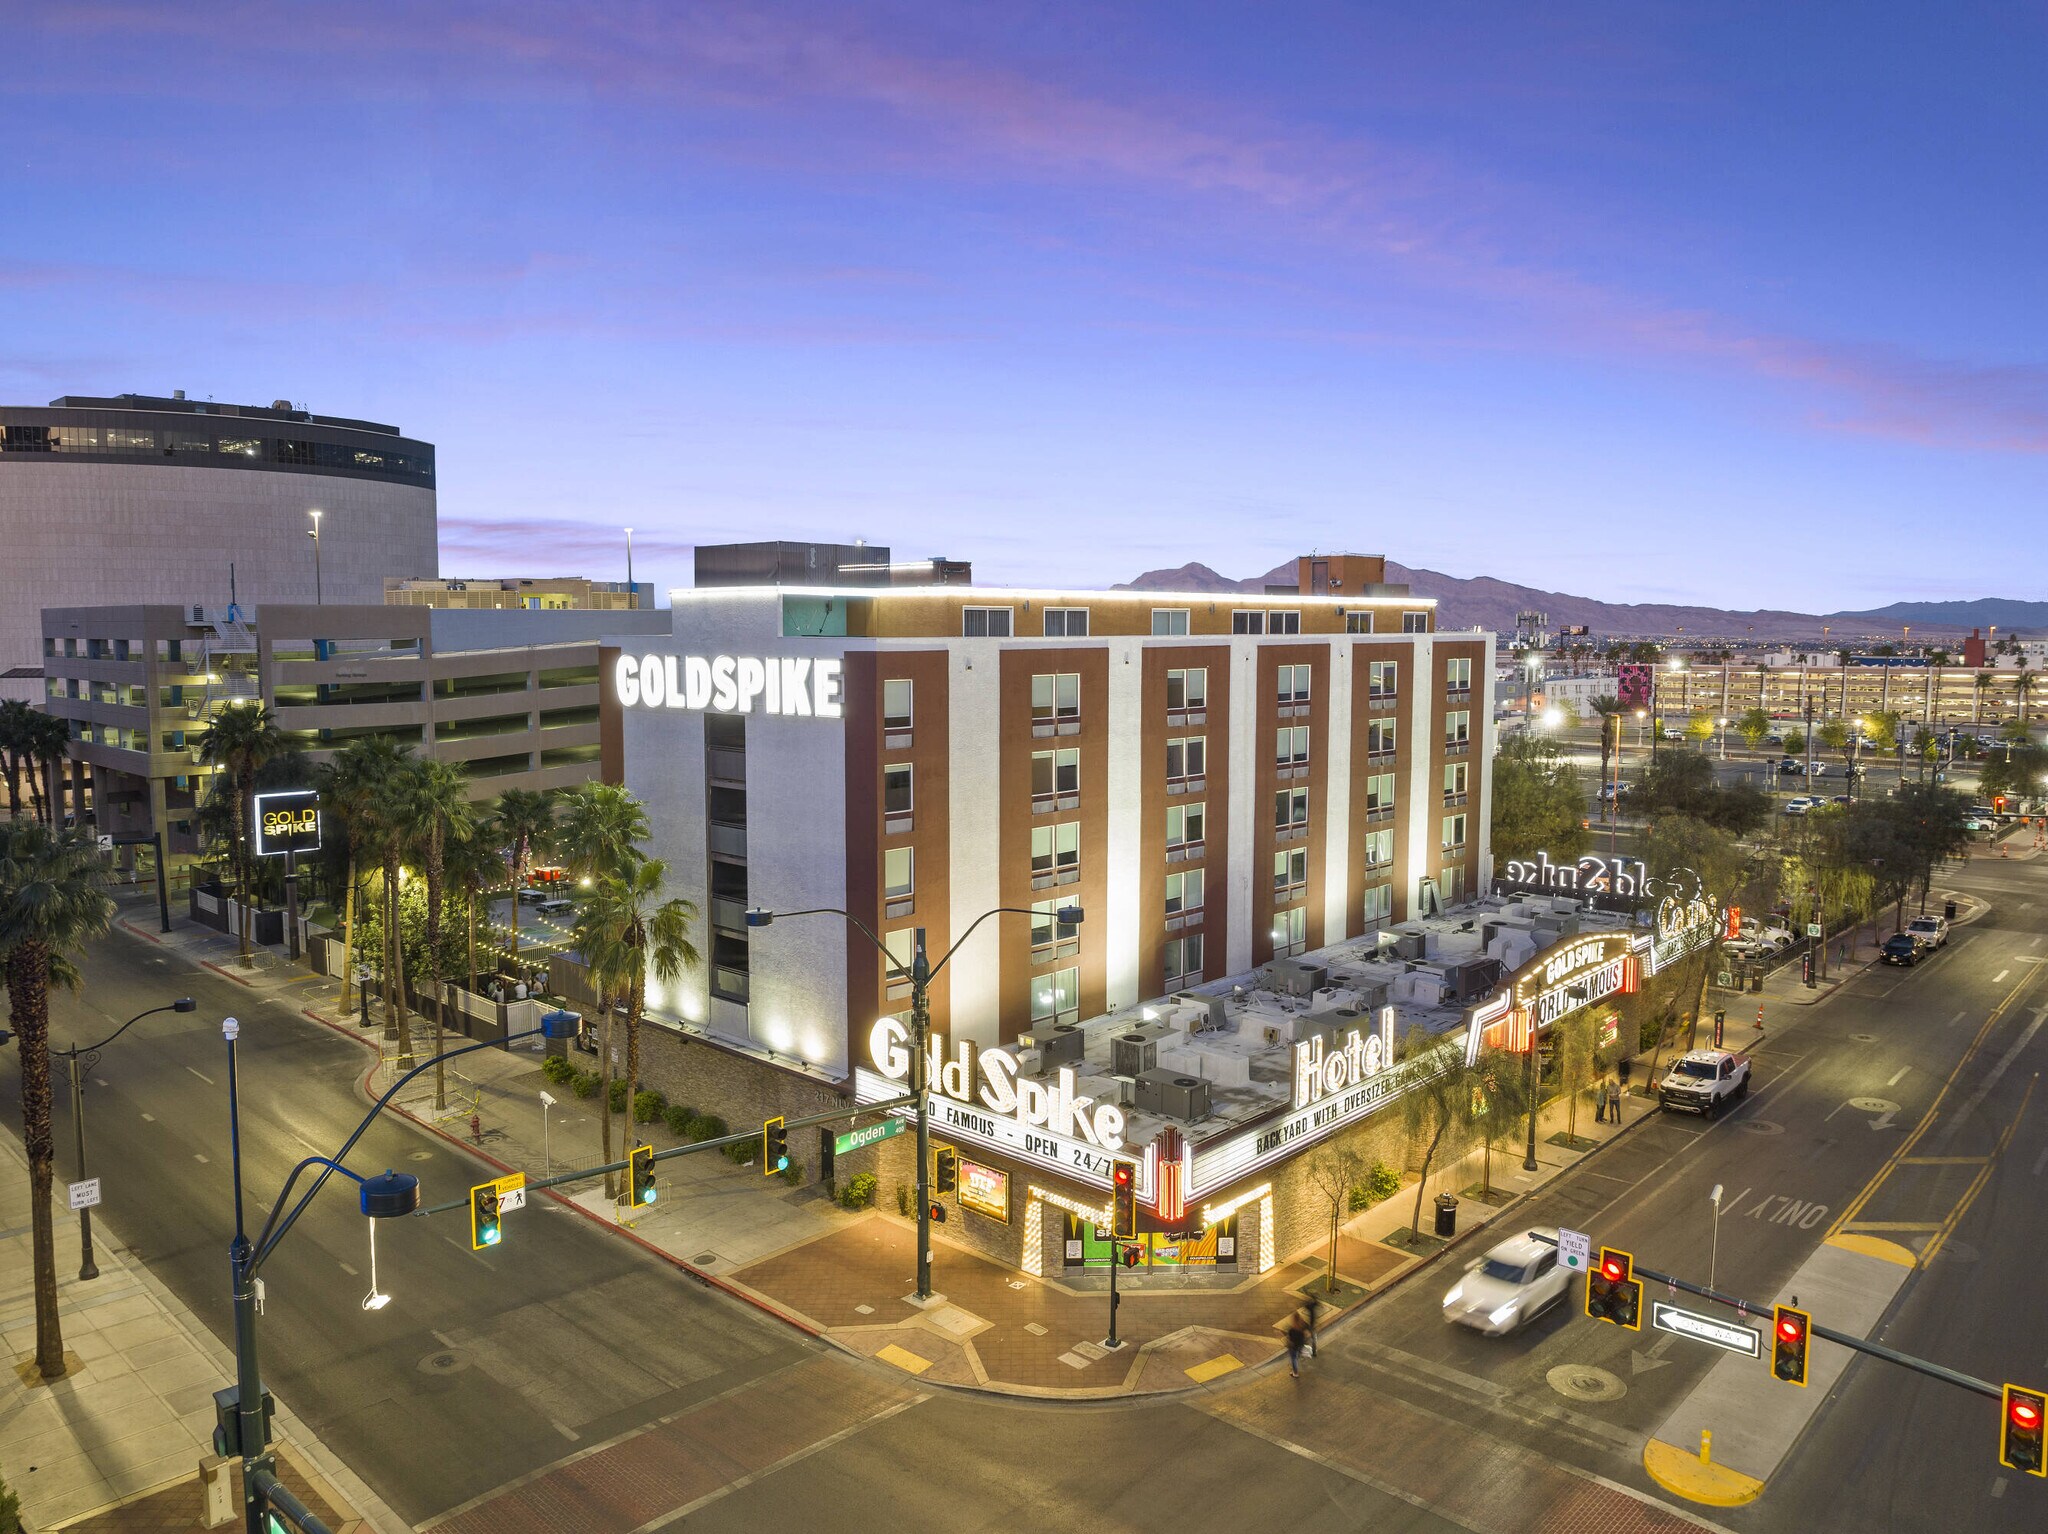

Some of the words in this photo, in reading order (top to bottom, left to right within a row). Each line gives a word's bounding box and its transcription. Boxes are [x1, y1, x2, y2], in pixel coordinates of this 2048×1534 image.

[616, 654, 844, 718] GOLDSPIKE
[263, 809, 315, 826] GOLD
[263, 821, 316, 837] SPIKE
[1295, 1006, 1395, 1111] Hotel
[869, 1017, 976, 1103] Gld
[978, 1048, 1125, 1150] Spike
[1313, 1102, 1338, 1127] WITH
[850, 1126, 886, 1147] Ogden
[895, 1118, 905, 1126] Ave
[895, 1126, 905, 1134] 400
[946, 1107, 995, 1138] FAMOUS
[1025, 1134, 1059, 1158] OPEN
[1073, 1149, 1111, 1177] 24/7
[85, 1181, 98, 1189] LANE
[501, 1181, 522, 1190] VEHICLES
[76, 1190, 93, 1198] MUST
[87, 1196, 99, 1204] LEFT
[1743, 1194, 1829, 1230] ONLY
[1560, 1231, 1571, 1239] LEFT
[1576, 1235, 1588, 1243] TURN
[1566, 1239, 1583, 1250] YIELD
[1570, 1248, 1585, 1257] GREEN
[1681, 1319, 1705, 1334] ONE
[1712, 1328, 1742, 1343] WAY
